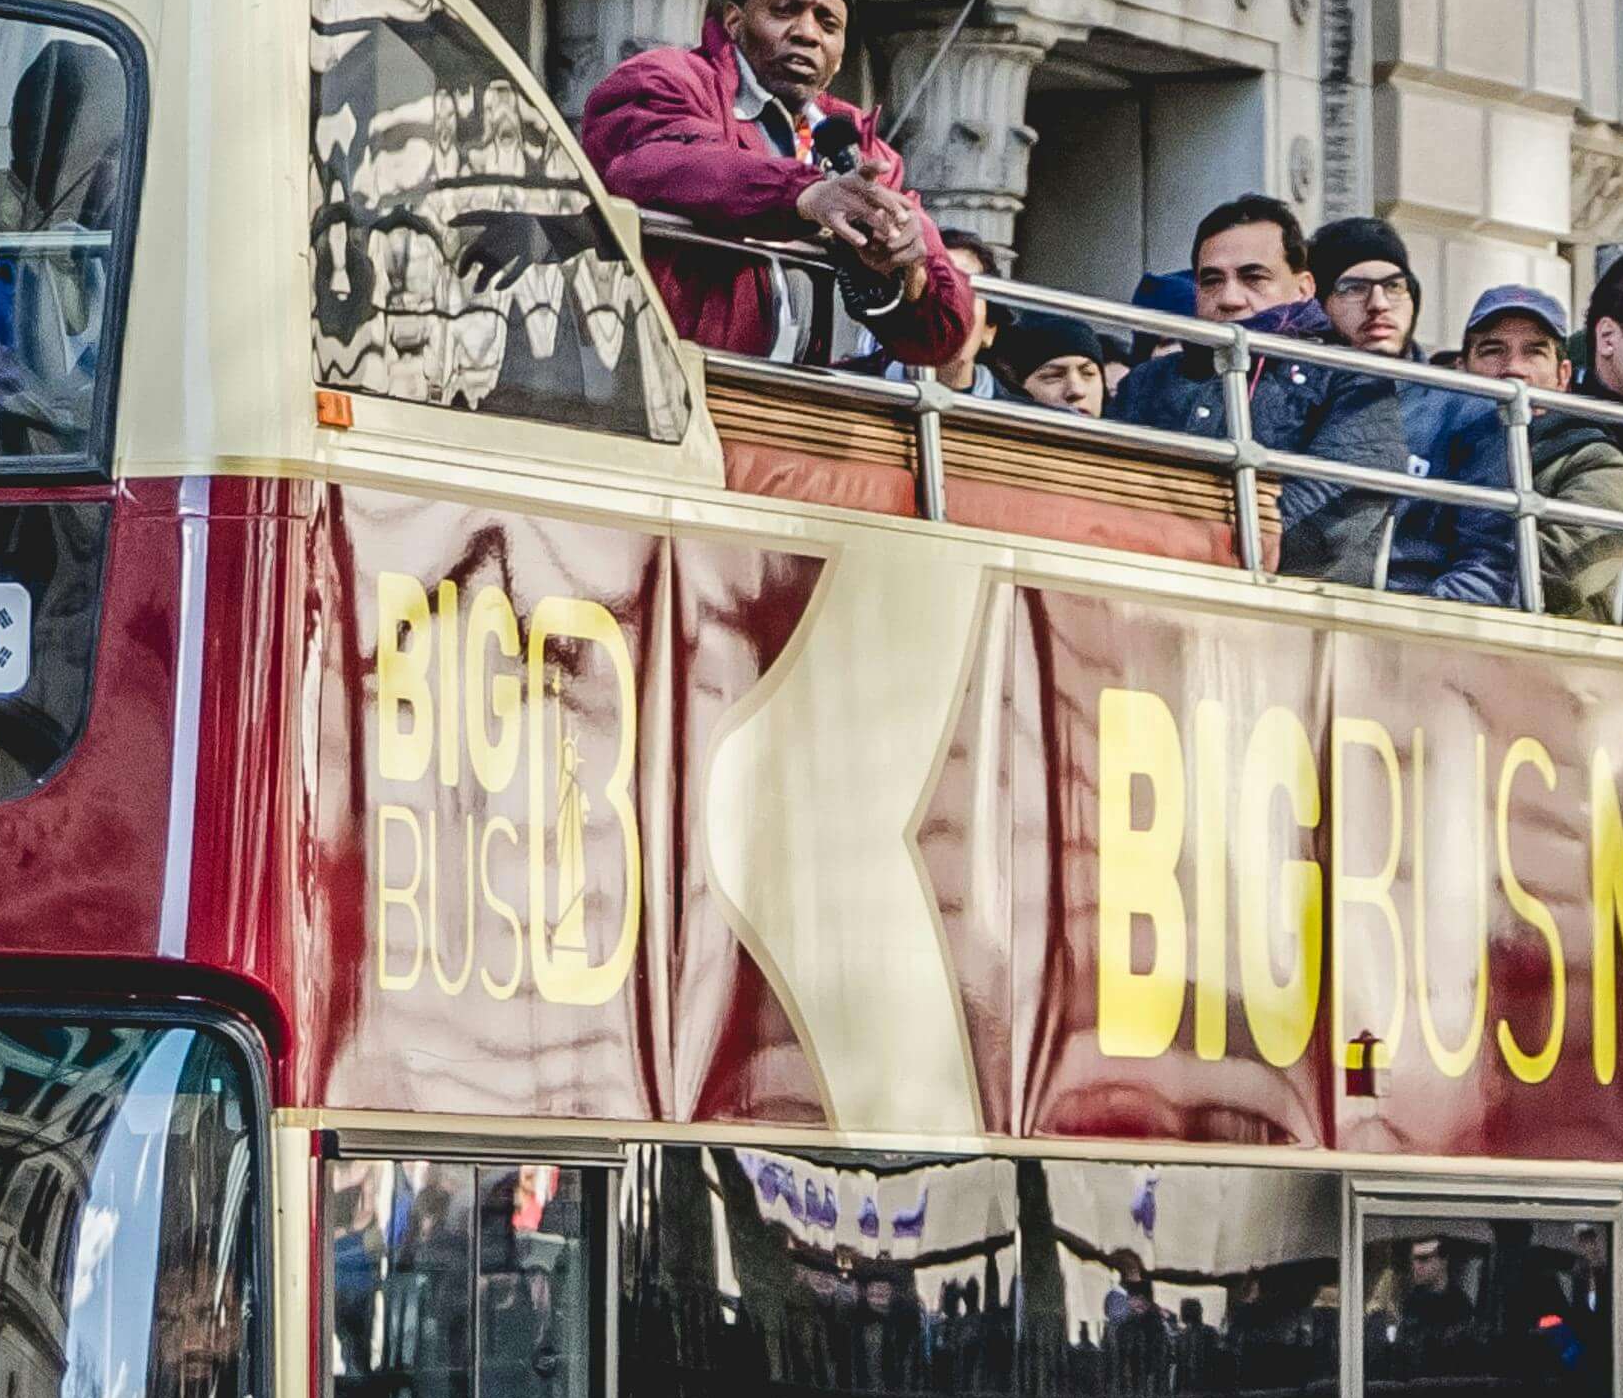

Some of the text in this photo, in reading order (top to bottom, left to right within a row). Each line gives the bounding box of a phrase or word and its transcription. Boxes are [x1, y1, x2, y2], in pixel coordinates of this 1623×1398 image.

[376, 570, 523, 794] BIG
[377, 804, 523, 1001] BUS
[1098, 688, 1322, 1069] BIG
[1331, 716, 1566, 1085] BUS
